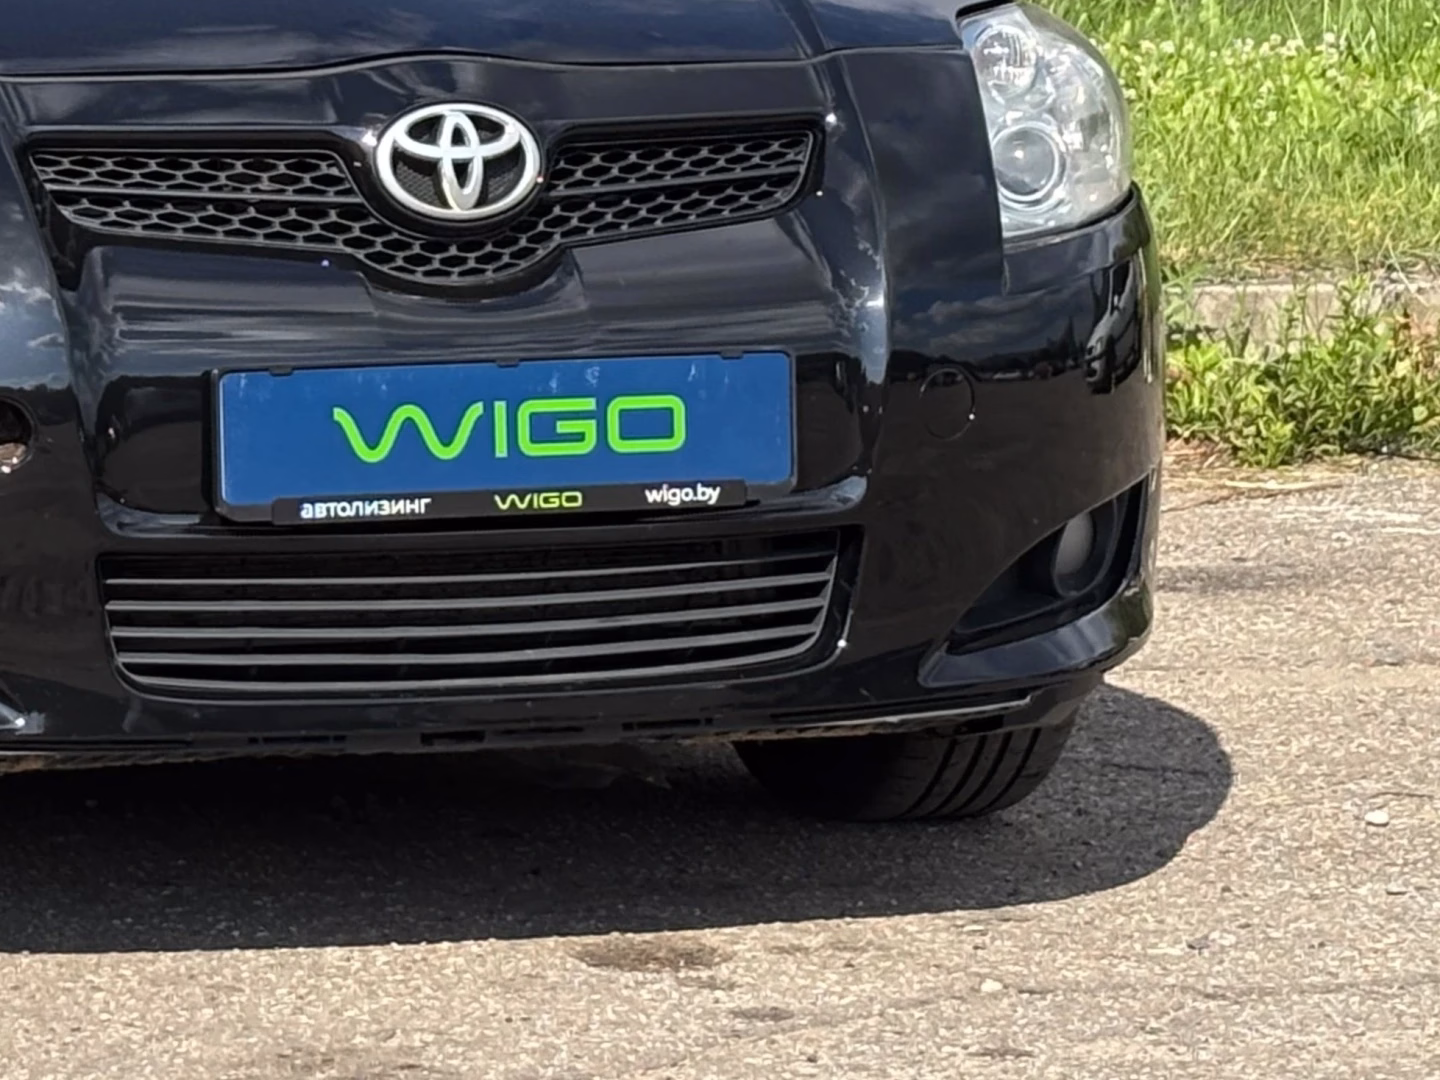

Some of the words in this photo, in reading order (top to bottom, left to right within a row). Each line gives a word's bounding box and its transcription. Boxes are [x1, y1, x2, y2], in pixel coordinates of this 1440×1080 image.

[333, 394, 686, 463] WIGO
[494, 491, 583, 510] WIGO
[644, 483, 721, 506] wigo.by
[300, 496, 432, 520] автолизинг
